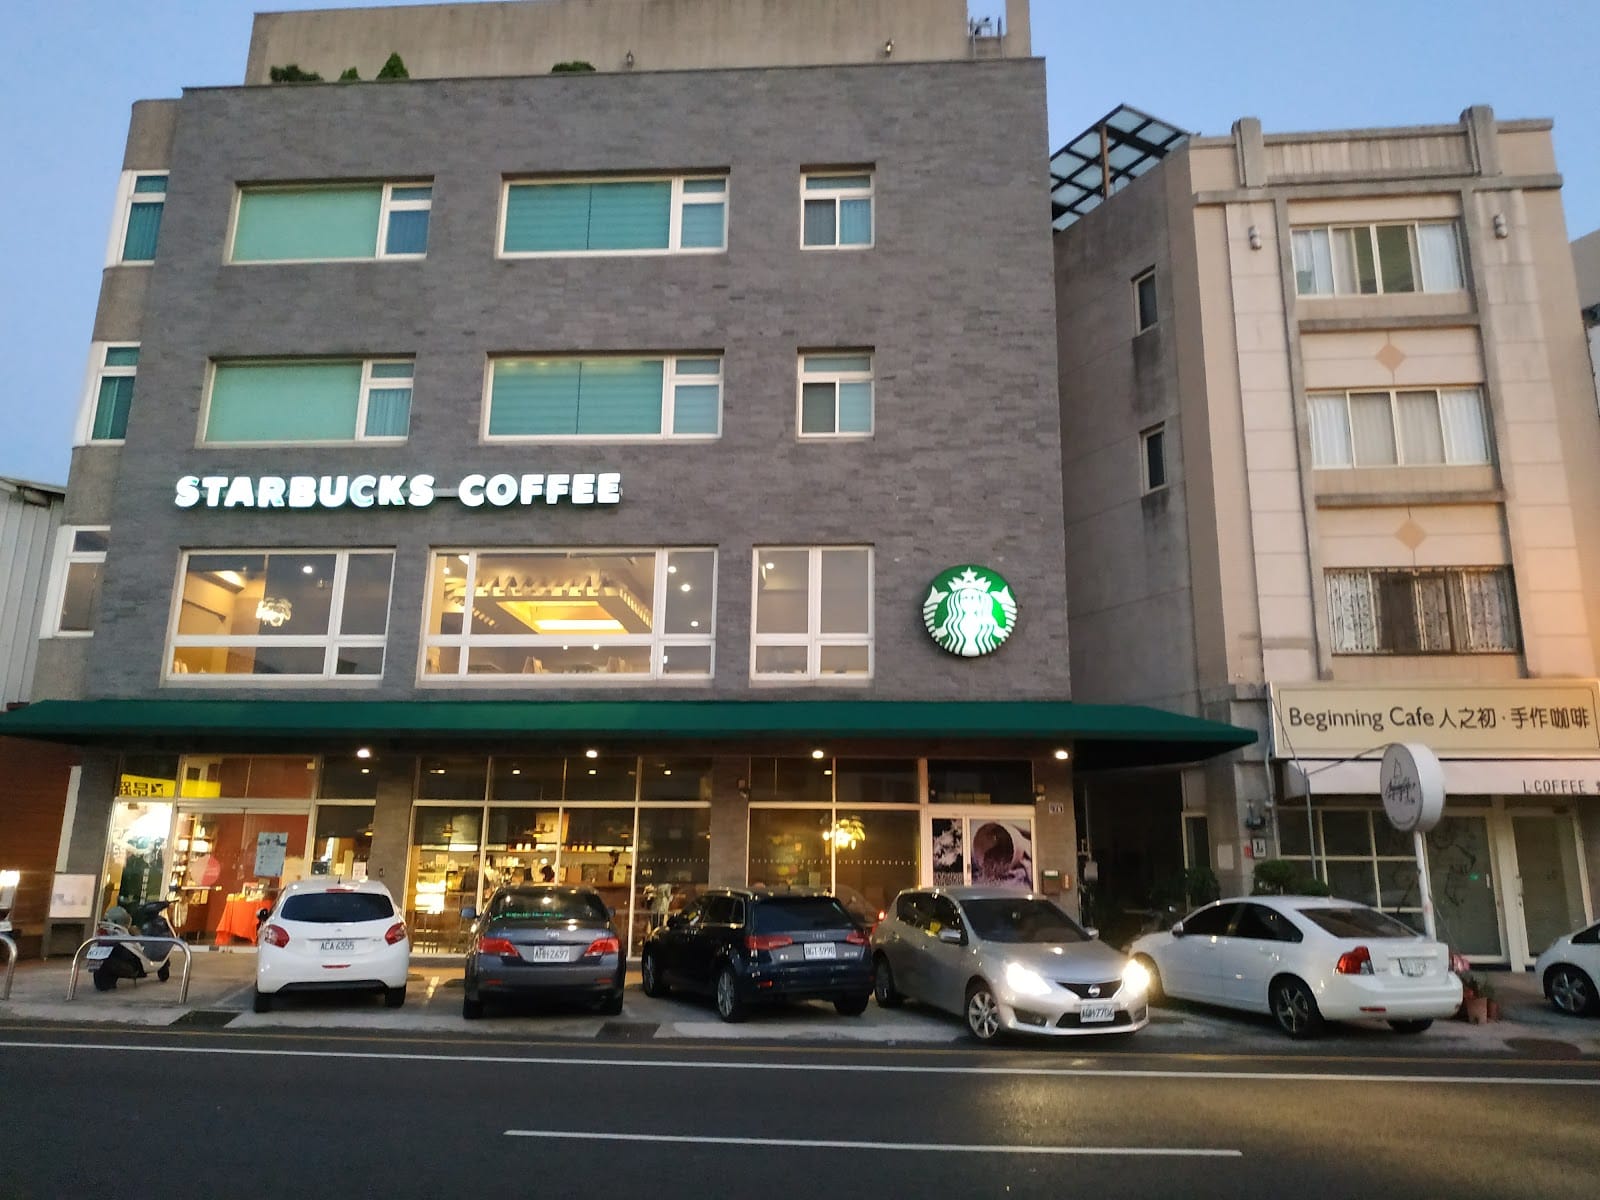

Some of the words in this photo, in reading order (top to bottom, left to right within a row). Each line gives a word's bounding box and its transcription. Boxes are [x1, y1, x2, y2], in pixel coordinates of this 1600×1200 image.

[175, 475, 434, 508] STARBUCKS
[458, 472, 621, 507] COFFEE
[1289, 707, 1384, 732] Beginning
[1389, 706, 1434, 726] Cafe
